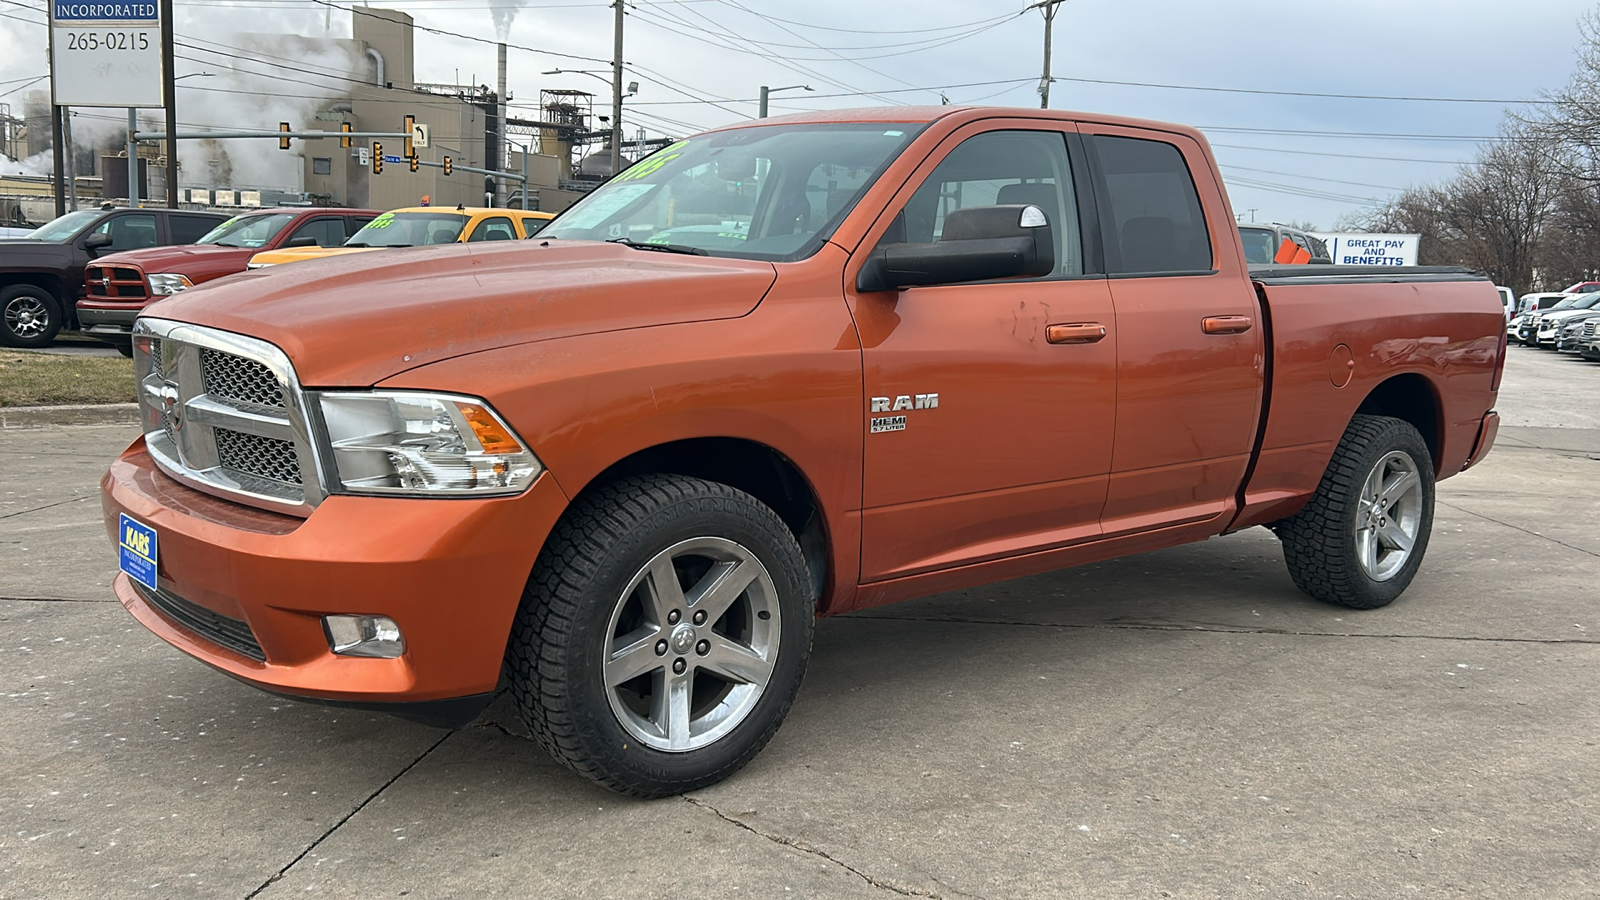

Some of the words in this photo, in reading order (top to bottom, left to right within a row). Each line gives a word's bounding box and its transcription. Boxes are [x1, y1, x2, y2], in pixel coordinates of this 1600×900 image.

[57, 4, 155, 17] INCORPORATED
[67, 32, 149, 50] 265-0215
[1347, 239, 1381, 248] GREAT
[1384, 240, 1405, 249] PAY
[1363, 248, 1386, 256] AND
[1343, 255, 1404, 266] BENEFITS
[870, 391, 939, 413] RAM
[872, 416, 906, 427] HEMI
[125, 525, 150, 556] KARS
